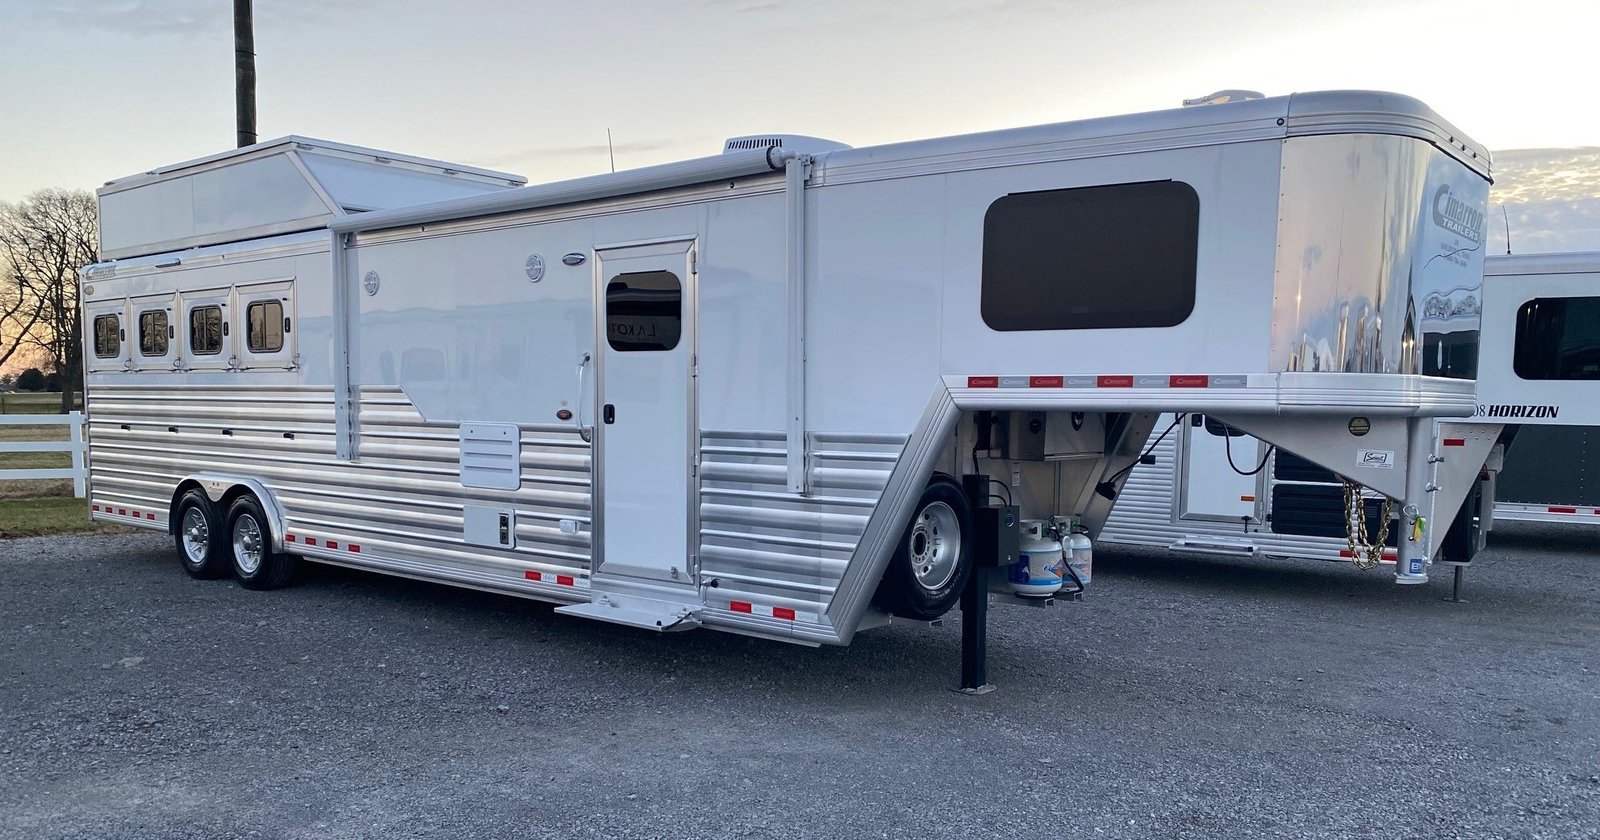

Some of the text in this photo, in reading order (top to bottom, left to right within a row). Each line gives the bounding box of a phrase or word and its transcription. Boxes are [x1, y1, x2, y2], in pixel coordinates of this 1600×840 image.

[1433, 184, 1483, 232] Cimarron
[1442, 217, 1479, 241] TRAILERS
[1488, 405, 1560, 418] HORIZON
